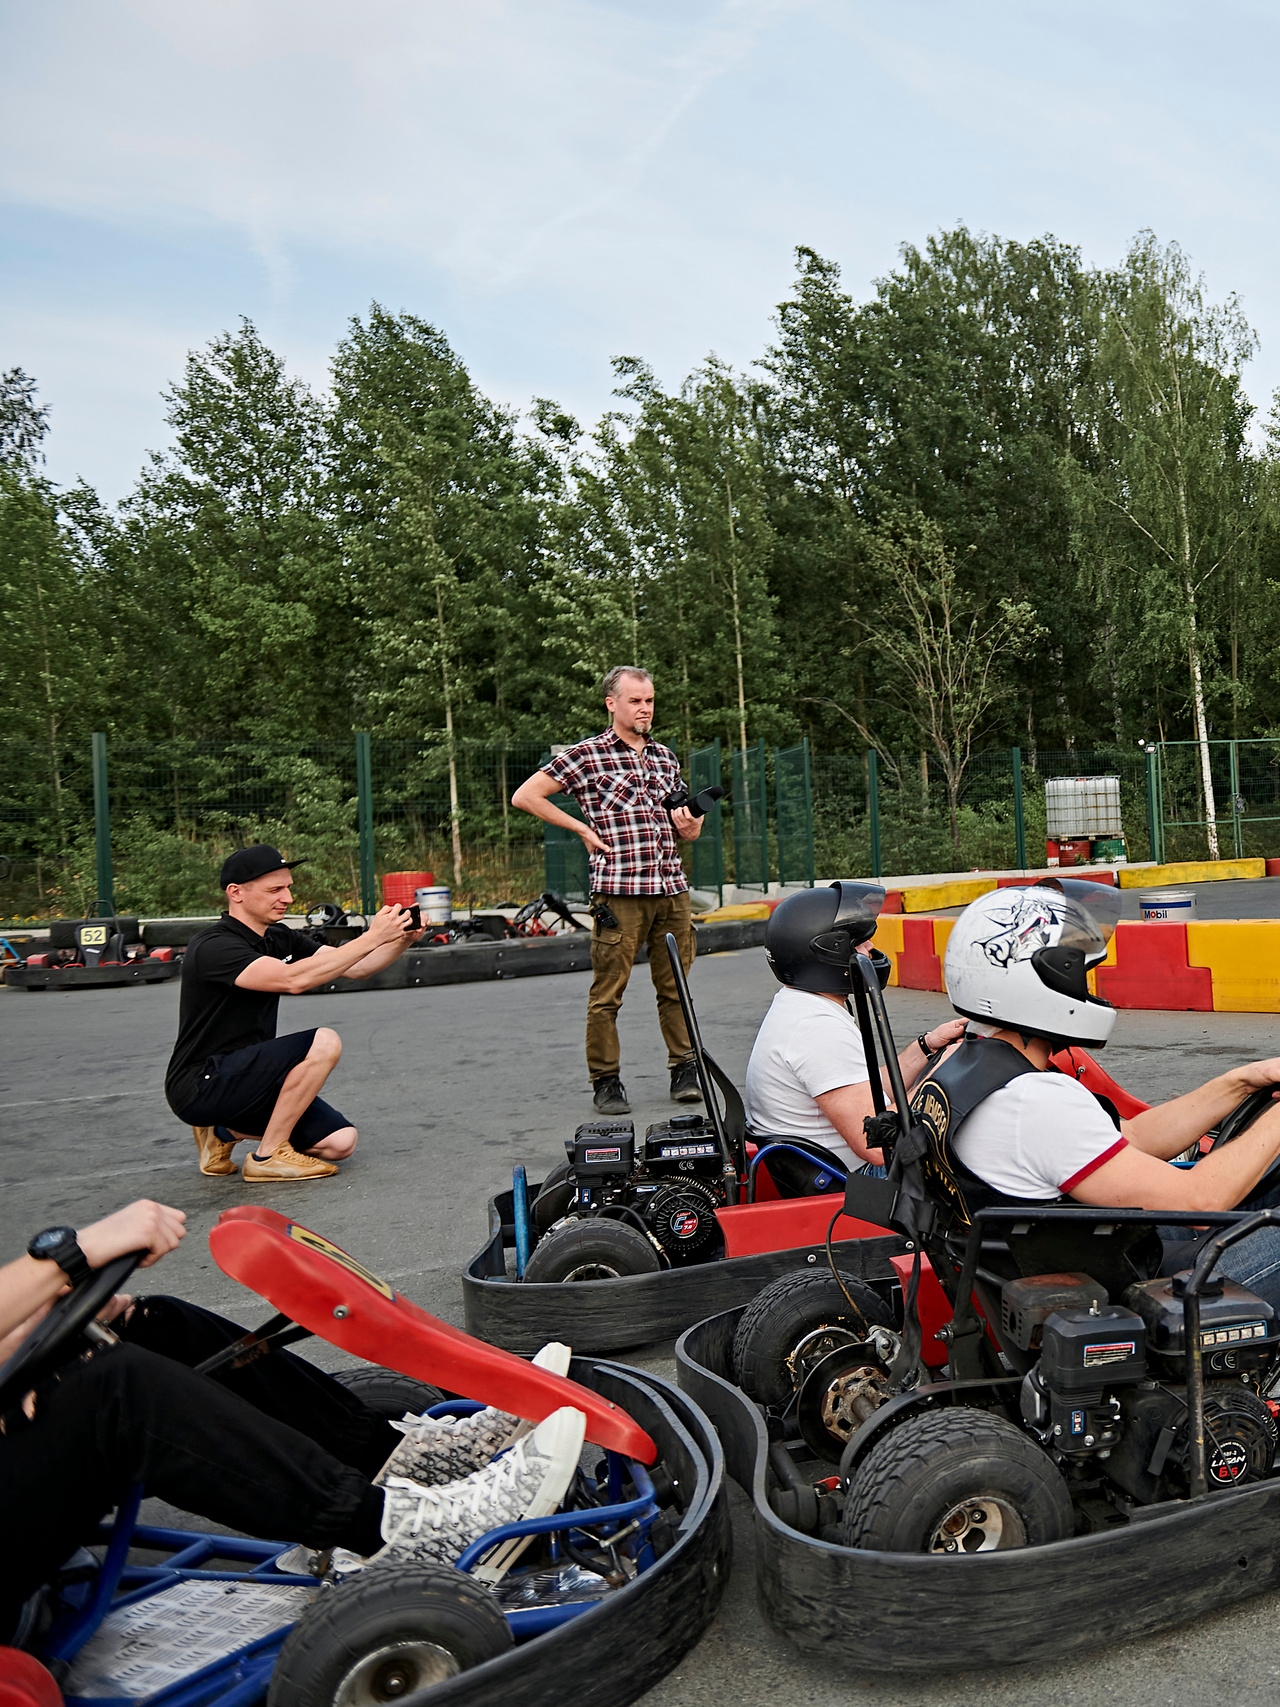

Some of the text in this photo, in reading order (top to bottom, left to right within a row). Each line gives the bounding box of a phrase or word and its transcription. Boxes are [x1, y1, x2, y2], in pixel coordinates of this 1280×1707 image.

[1144, 910, 1168, 919] Mobil
[84, 930, 103, 942] 52
[1210, 1350, 1237, 1371] CE
[1218, 1465, 1239, 1478] 6.5
